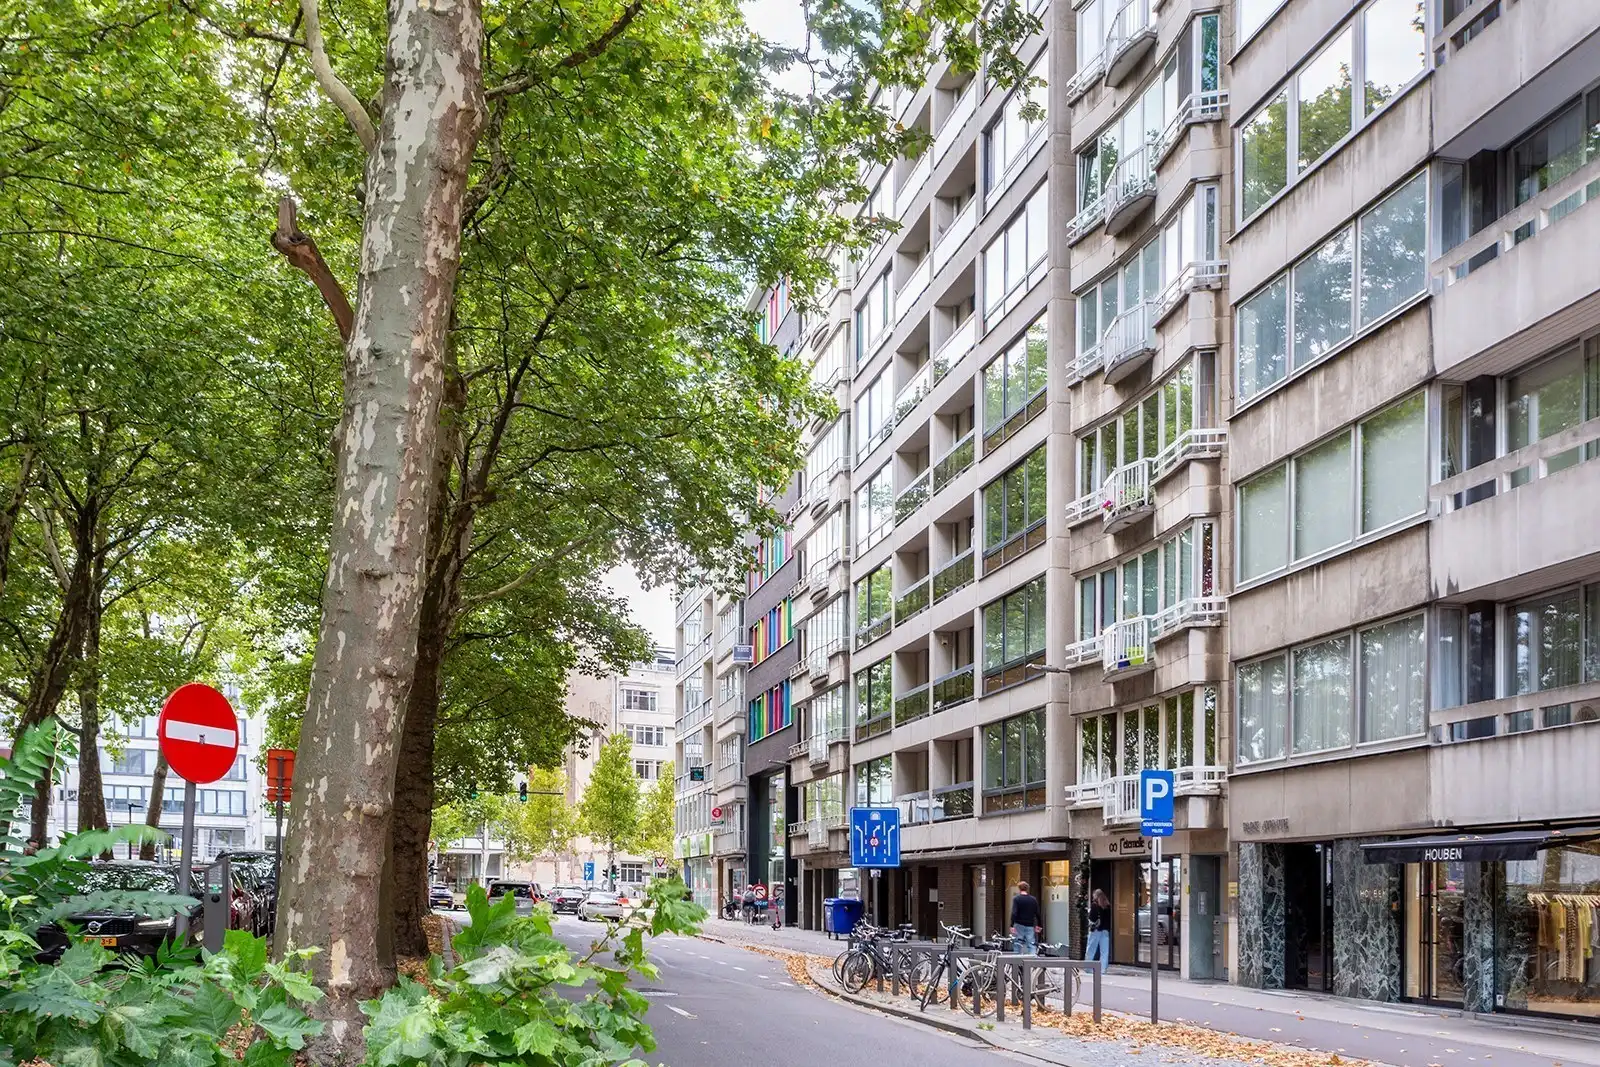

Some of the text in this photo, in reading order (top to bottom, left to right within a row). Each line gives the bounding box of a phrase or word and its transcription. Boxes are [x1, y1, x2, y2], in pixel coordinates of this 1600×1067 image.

[1146, 778, 1169, 810] P
[1424, 848, 1463, 860] HOUBEN
[1360, 889, 1388, 898] HOBEN
